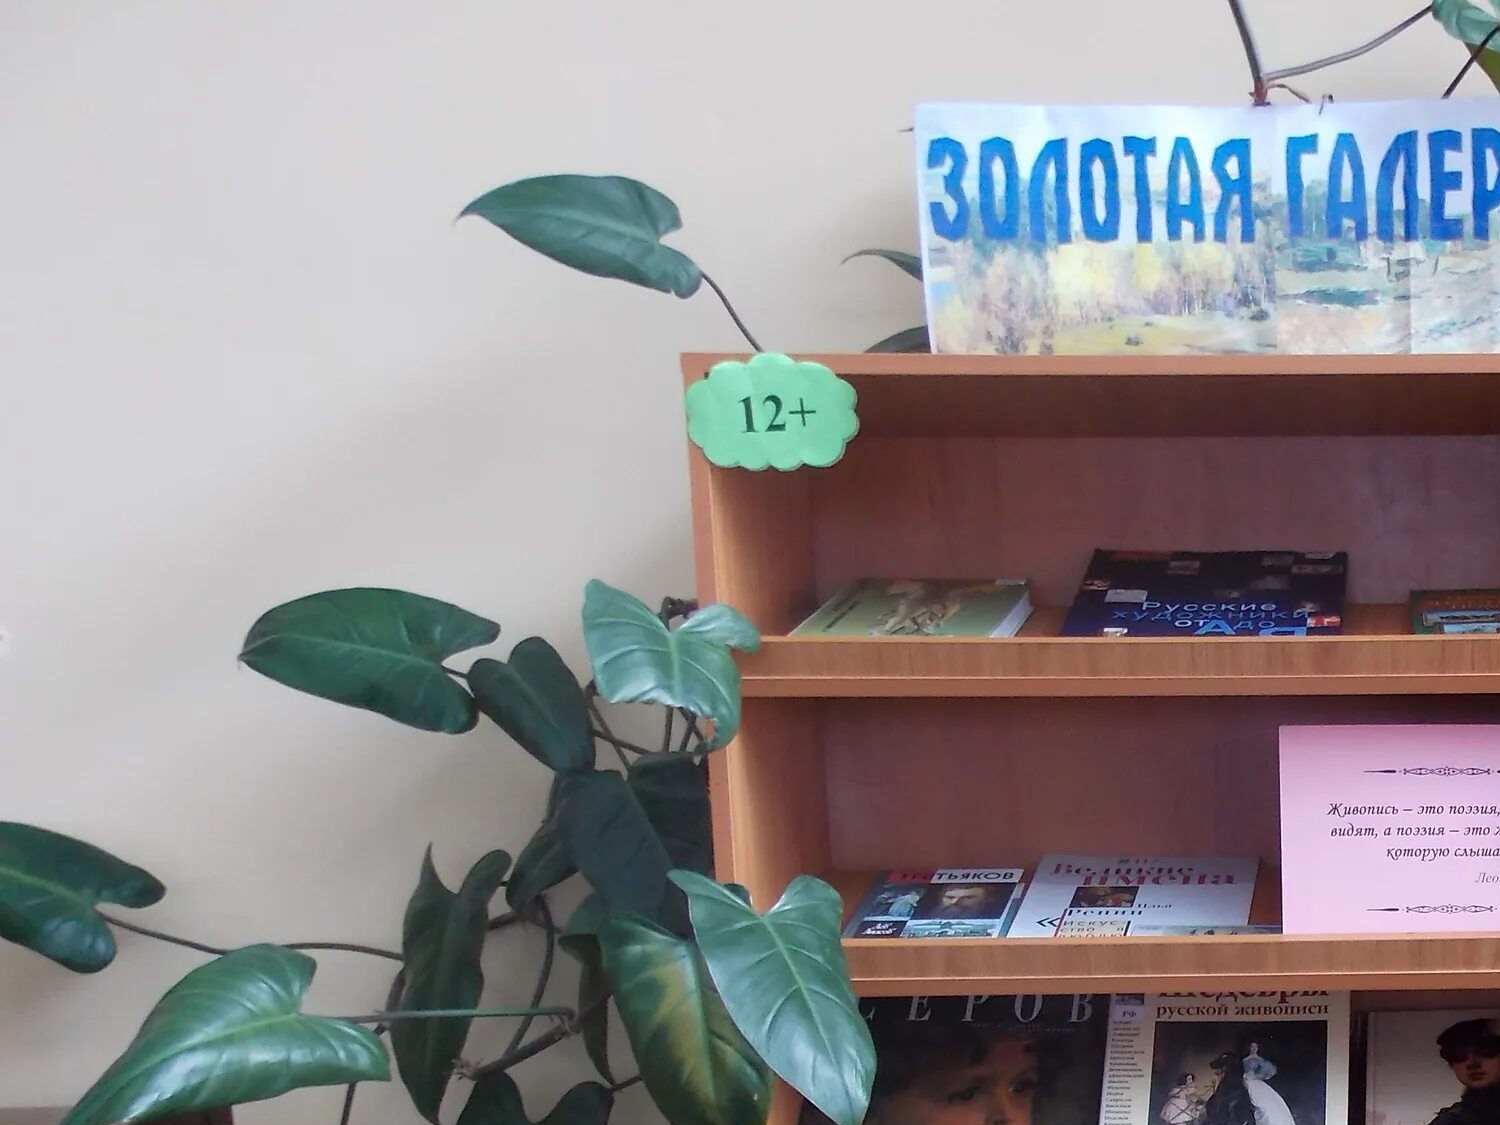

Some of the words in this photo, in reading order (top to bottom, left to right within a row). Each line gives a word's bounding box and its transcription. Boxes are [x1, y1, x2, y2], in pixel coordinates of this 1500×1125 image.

[928, 135, 1255, 243] ЗОЛОТАЯ
[739, 394, 818, 434] 12+
[1113, 608, 1310, 620] художники
[1142, 601, 1277, 612] Русские
[1194, 619, 1237, 636] А
[1233, 620, 1276, 630] до
[1326, 802, 1399, 818] Живопись
[1417, 804, 1444, 815] это
[1449, 804, 1500, 817] поэзия,
[1330, 823, 1379, 838] видят,
[1383, 826, 1392, 836] а
[1396, 826, 1445, 837] поэзия
[1463, 825, 1491, 836] это
[1386, 846, 1450, 861] которую
[1156, 1004, 1229, 1019] русской
[1234, 1003, 1330, 1016] живописи
